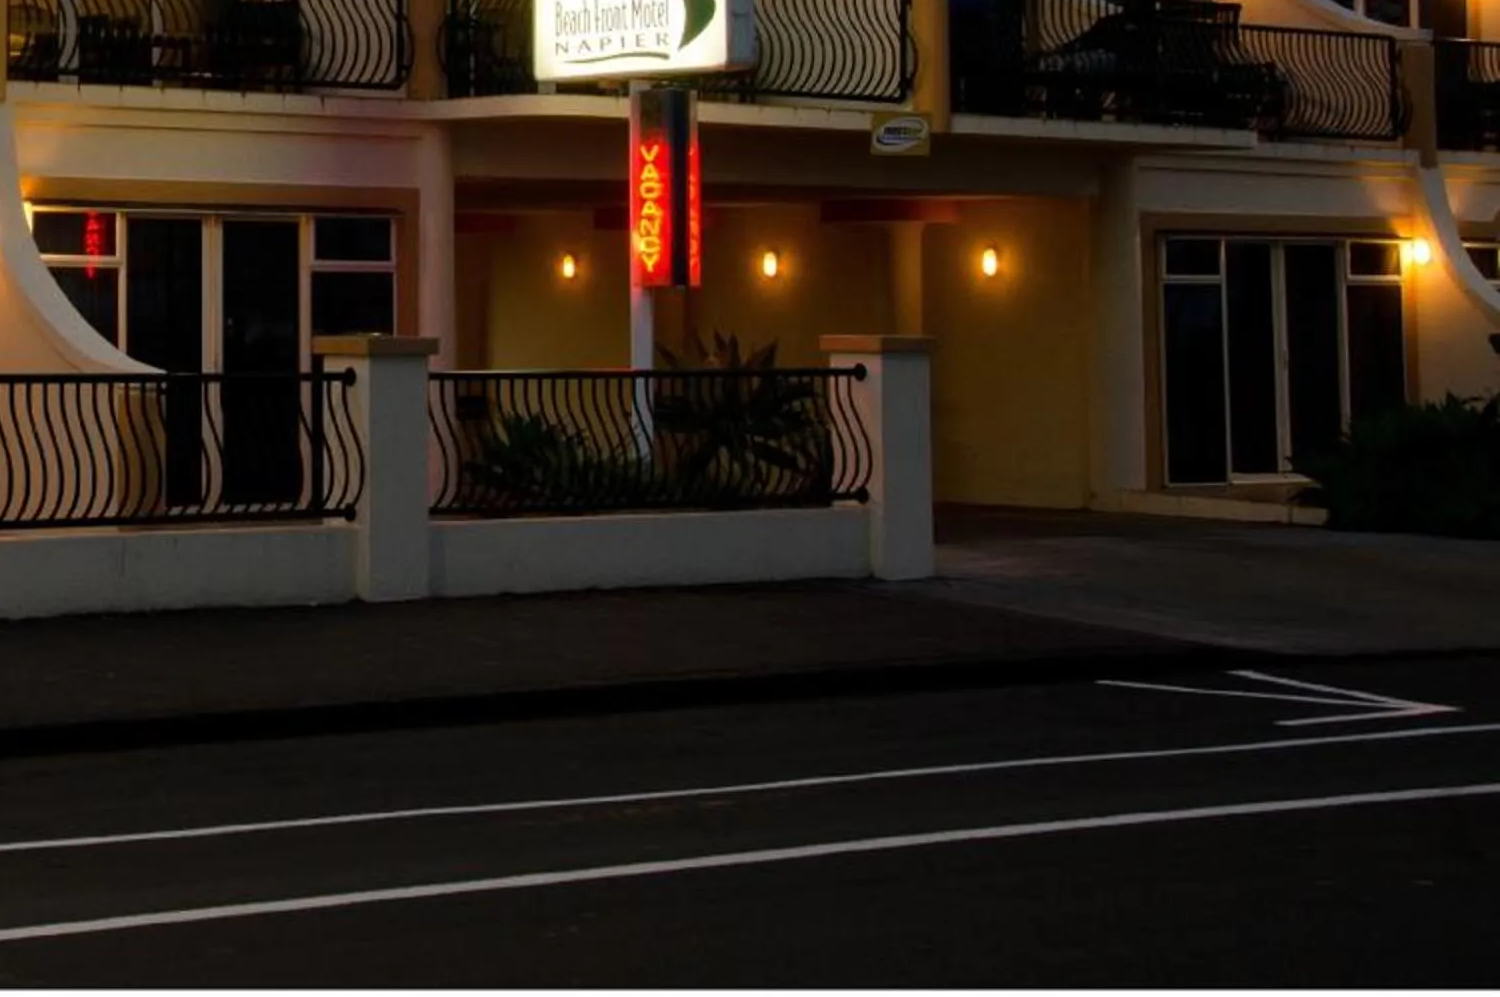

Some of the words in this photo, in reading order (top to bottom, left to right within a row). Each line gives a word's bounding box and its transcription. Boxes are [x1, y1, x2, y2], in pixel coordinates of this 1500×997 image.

[555, 0, 591, 37] Beach
[555, 32, 669, 56] NAPIER
[640, 144, 662, 273] VACANCY
